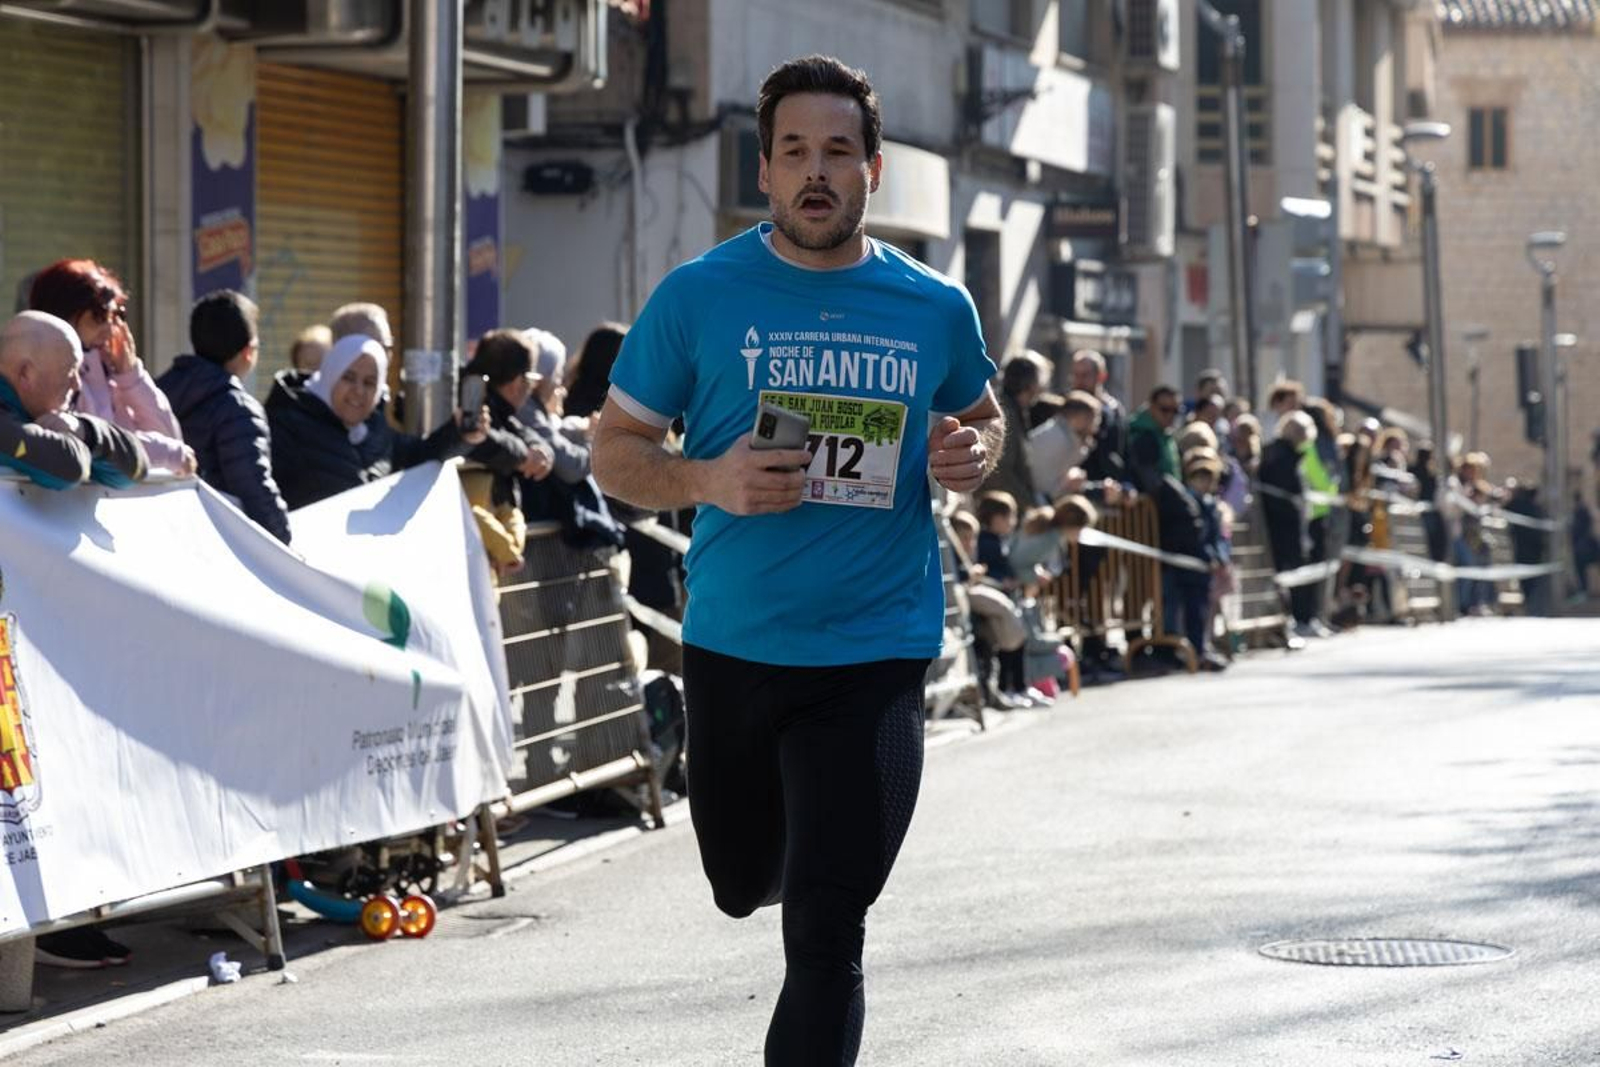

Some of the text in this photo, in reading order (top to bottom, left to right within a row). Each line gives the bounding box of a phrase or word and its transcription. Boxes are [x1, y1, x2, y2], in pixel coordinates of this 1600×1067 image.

[768, 332, 918, 352] XXXIV CARRERA URBANA INTERNACIONAL
[769, 347, 814, 358] NOCHE DE
[768, 350, 918, 397] SAN ANTÓN
[789, 397, 807, 411] SAN
[809, 399, 834, 413] JUAN
[837, 401, 863, 416] BOSCO
[820, 414, 855, 429] POPULAR
[802, 435, 864, 479] 712
